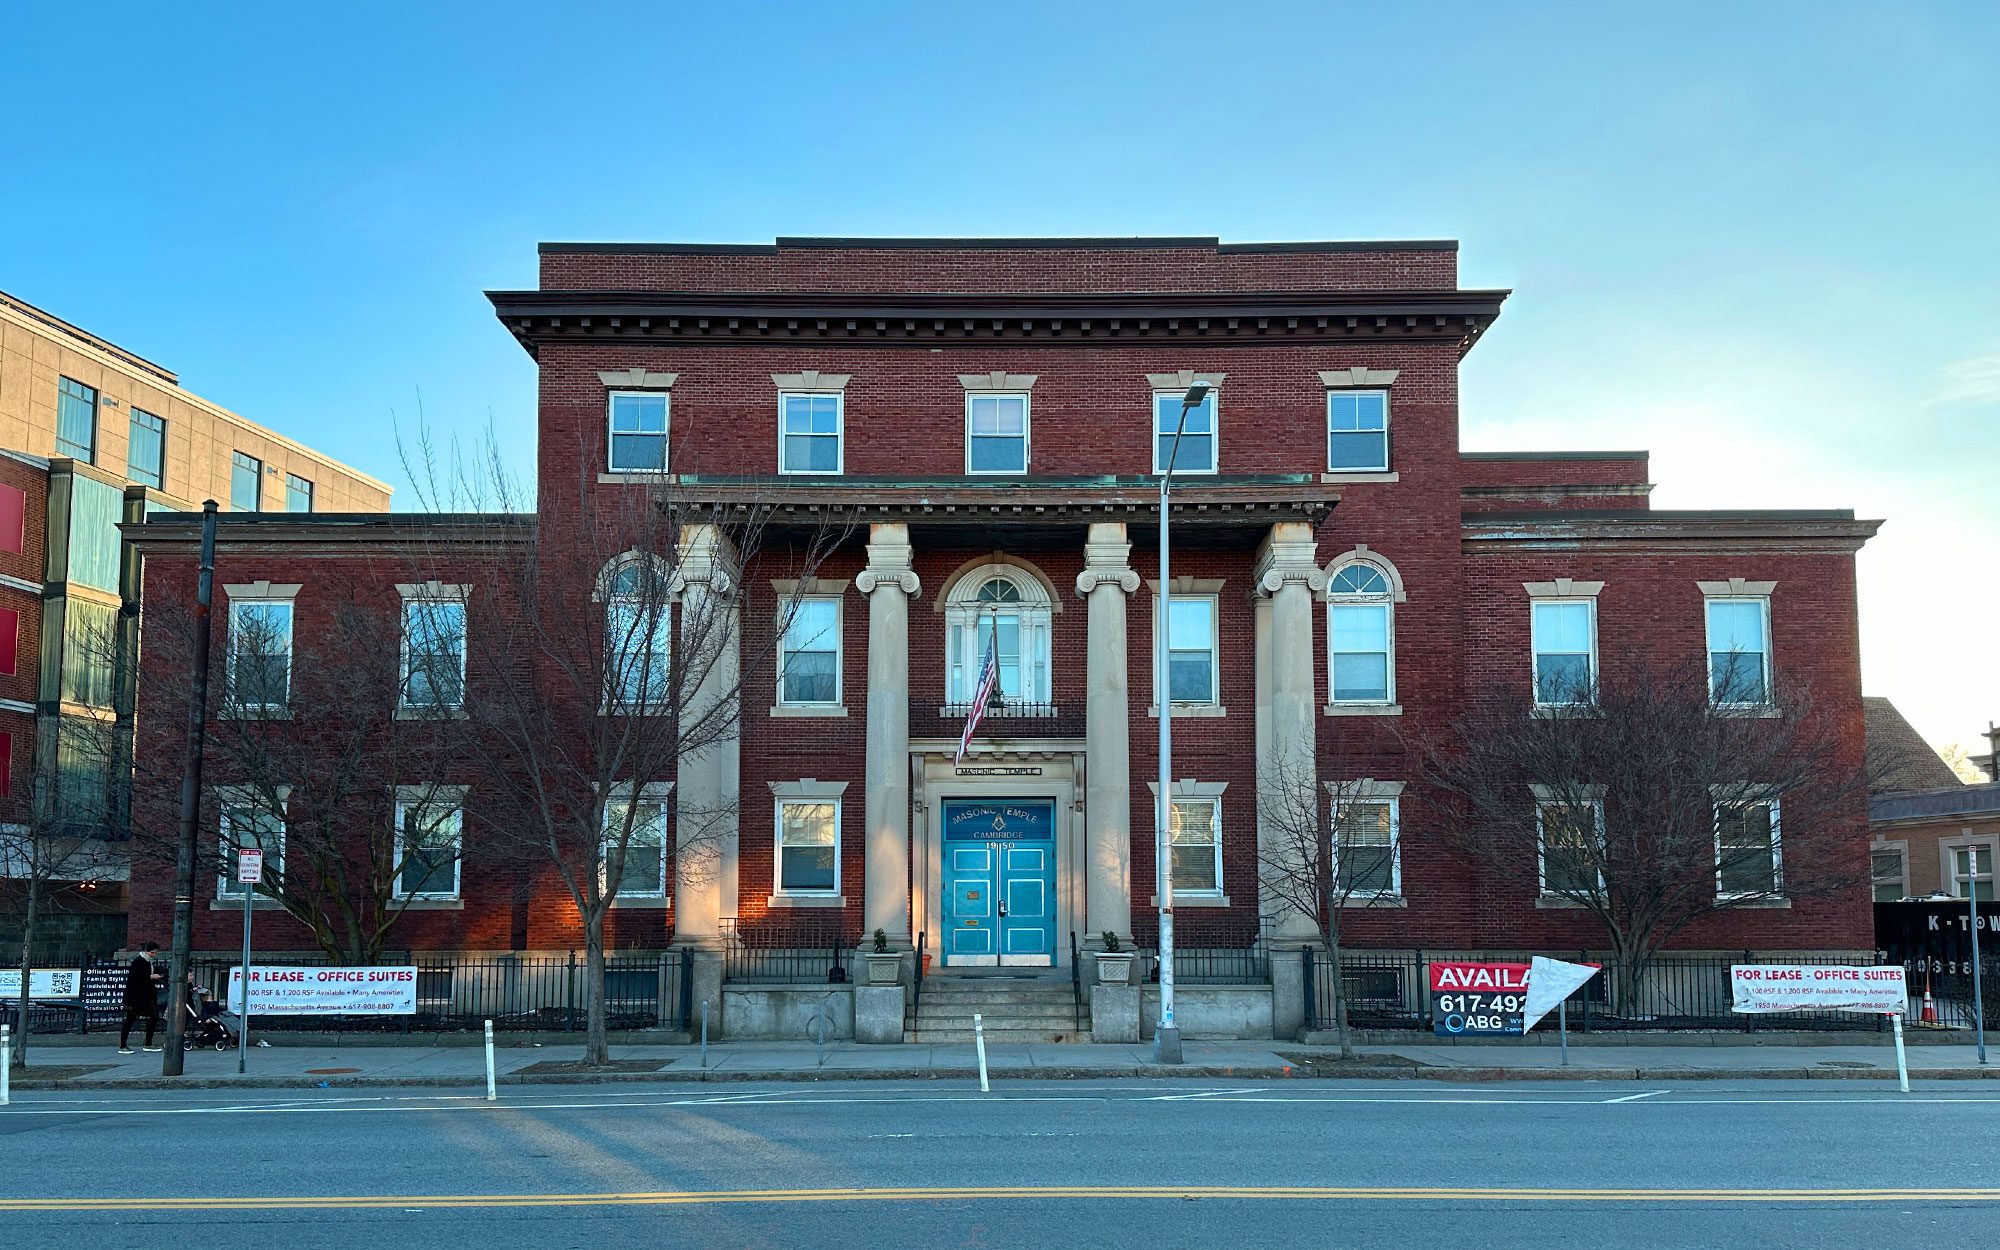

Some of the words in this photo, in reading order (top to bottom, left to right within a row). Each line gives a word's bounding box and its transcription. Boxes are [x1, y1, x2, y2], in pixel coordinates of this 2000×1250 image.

[952, 807, 997, 825] MASONIC
[1002, 806, 1038, 824] TEMPLE
[973, 831, 1024, 839] CAMBRIDGE
[234, 971, 260, 982] FR
[264, 971, 304, 982] LEASE
[317, 971, 364, 982] OFFICE
[368, 971, 413, 982] SUITES
[1735, 970, 1762, 980] FOR
[1765, 970, 1803, 980] LEASE
[1813, 970, 1860, 980] OFFICE
[1863, 970, 1903, 981] SUITES
[352, 989, 370, 997] Many
[1850, 988, 1868, 996] Many
[1465, 1015, 1502, 1029] ABG
